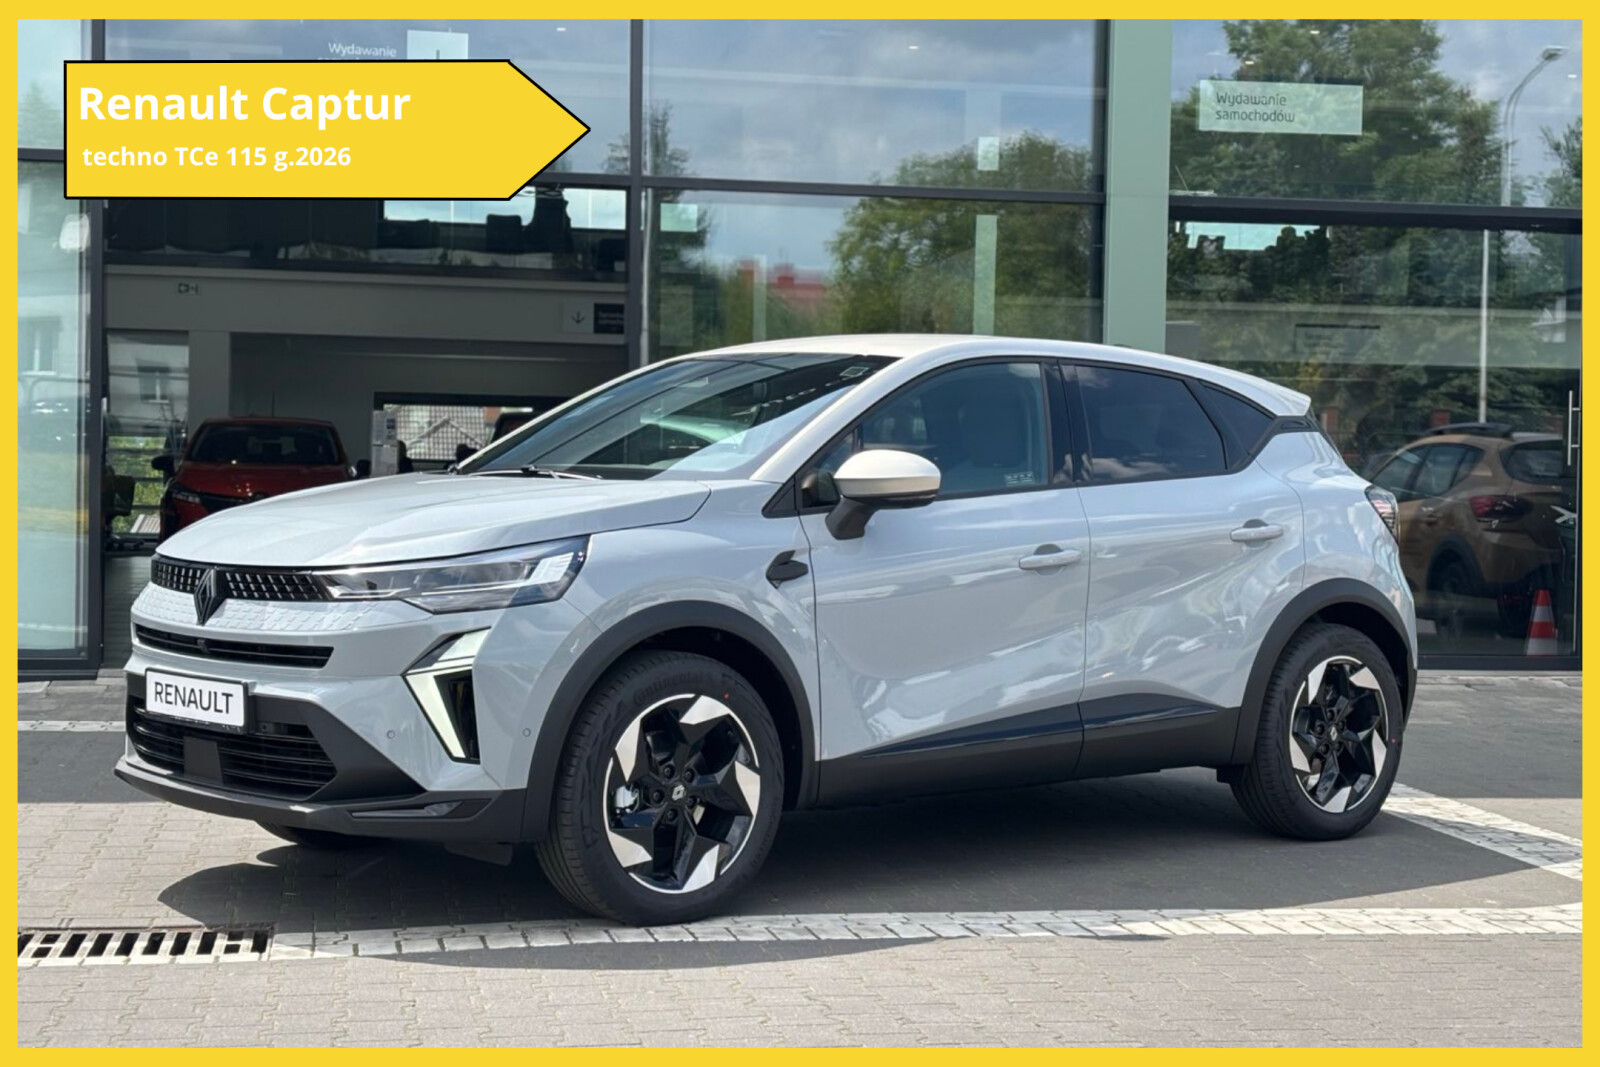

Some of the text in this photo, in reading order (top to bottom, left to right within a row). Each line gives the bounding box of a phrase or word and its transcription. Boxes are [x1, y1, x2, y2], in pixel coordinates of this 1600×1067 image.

[327, 42, 398, 57] Wydawanie
[1216, 92, 1287, 107] Wydawanie
[1215, 109, 1296, 123] samochodów
[154, 681, 234, 715] RENAULT
